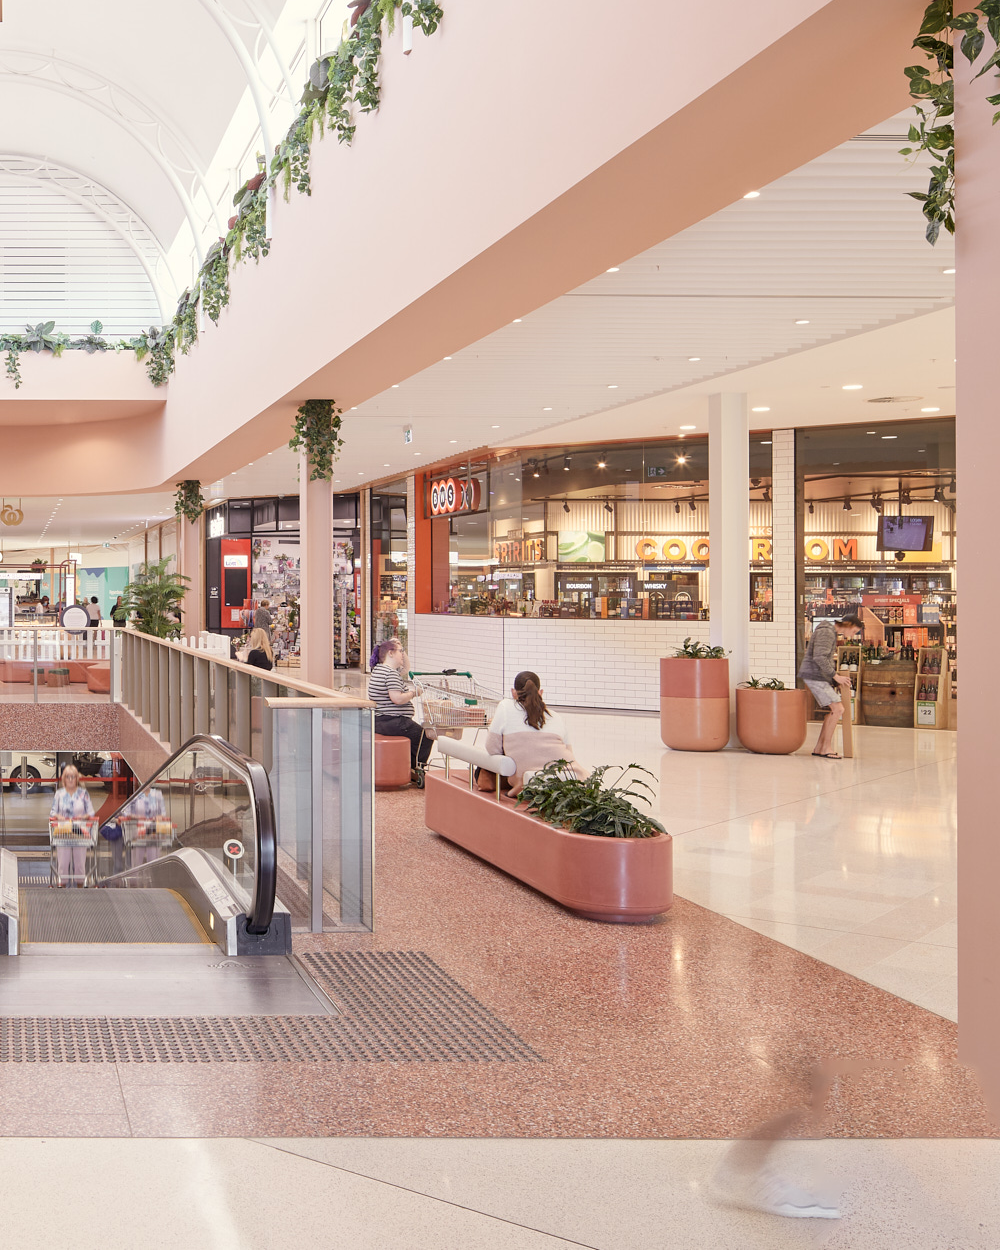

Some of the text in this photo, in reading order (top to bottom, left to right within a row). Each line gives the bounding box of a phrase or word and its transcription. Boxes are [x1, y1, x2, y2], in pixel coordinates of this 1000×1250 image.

[433, 489, 453, 504] BWS
[495, 539, 542, 562] SPIRITS
[635, 538, 858, 561] COO ROM
